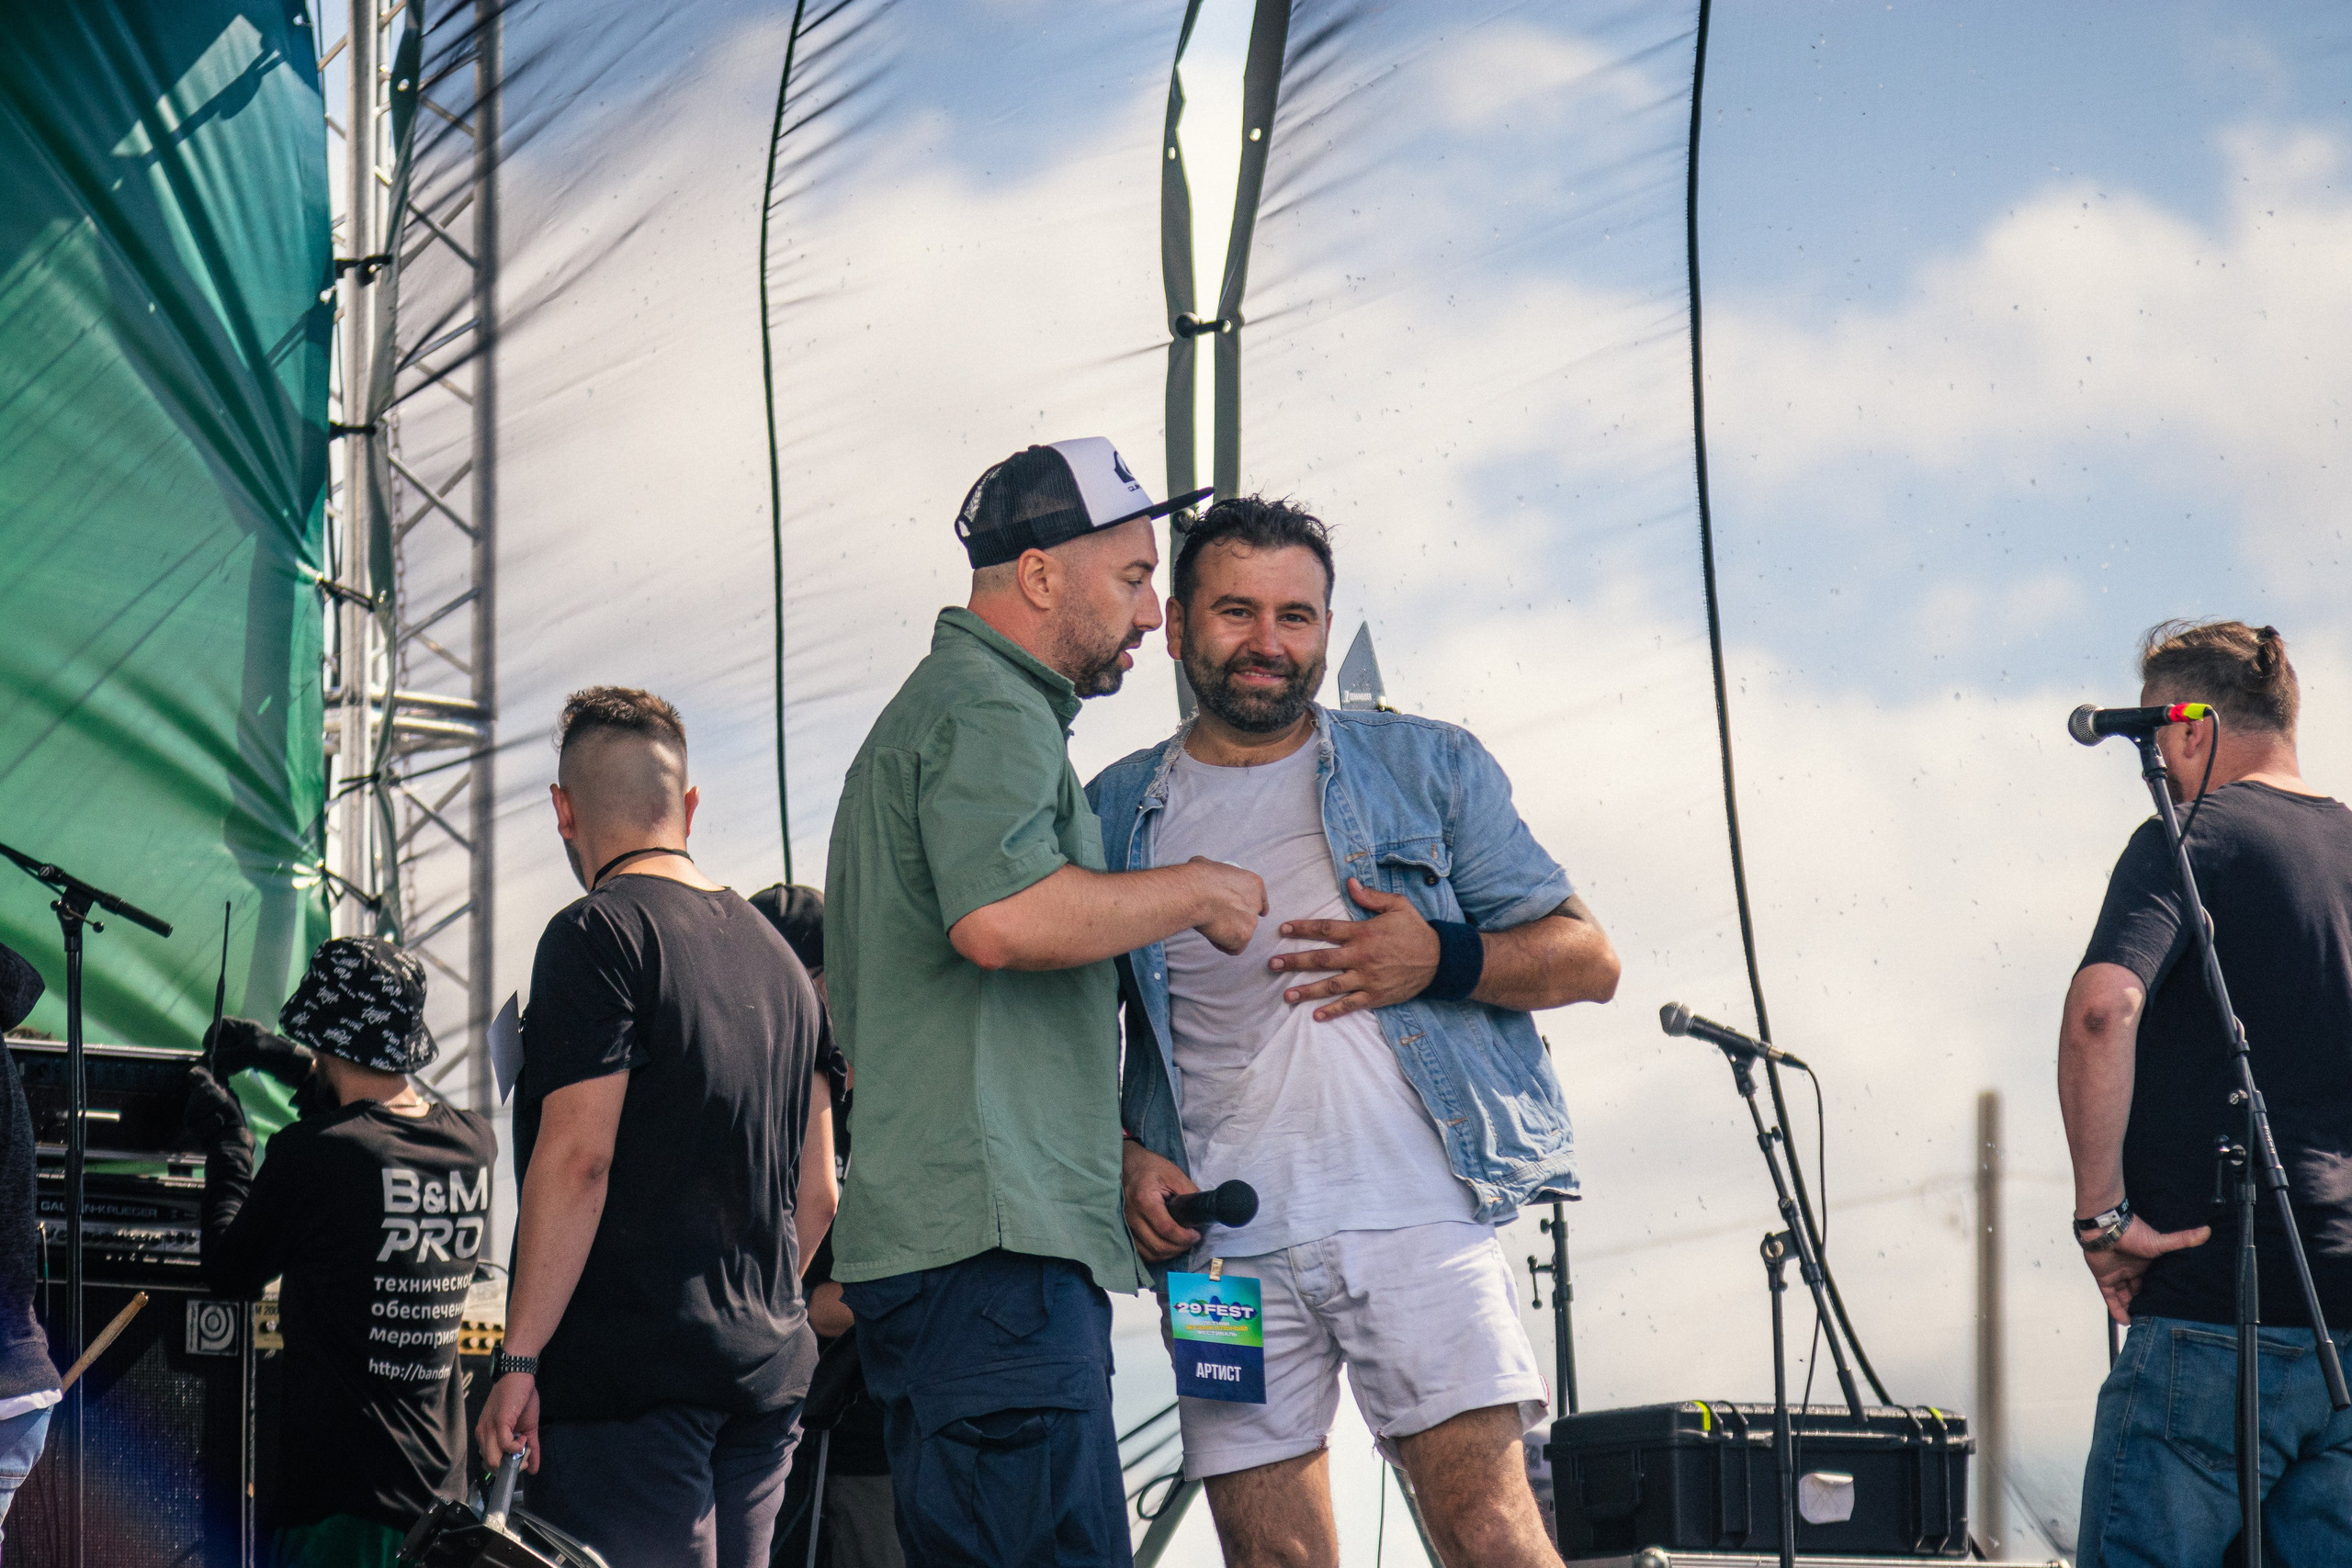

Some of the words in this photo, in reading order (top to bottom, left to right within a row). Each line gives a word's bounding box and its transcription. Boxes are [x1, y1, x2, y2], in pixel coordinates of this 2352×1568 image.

[381, 1166, 488, 1213] B&M
[40, 1201, 159, 1218] GALN-KRUEGER
[376, 1216, 484, 1263] PRO
[373, 1272, 473, 1293] техническое
[1178, 1302, 1202, 1314] 29
[1204, 1303, 1254, 1319] FEST
[368, 1326, 459, 1350] мероприят
[368, 1358, 452, 1382] http://bandm
[1196, 1362, 1241, 1382] АРТИСТ
